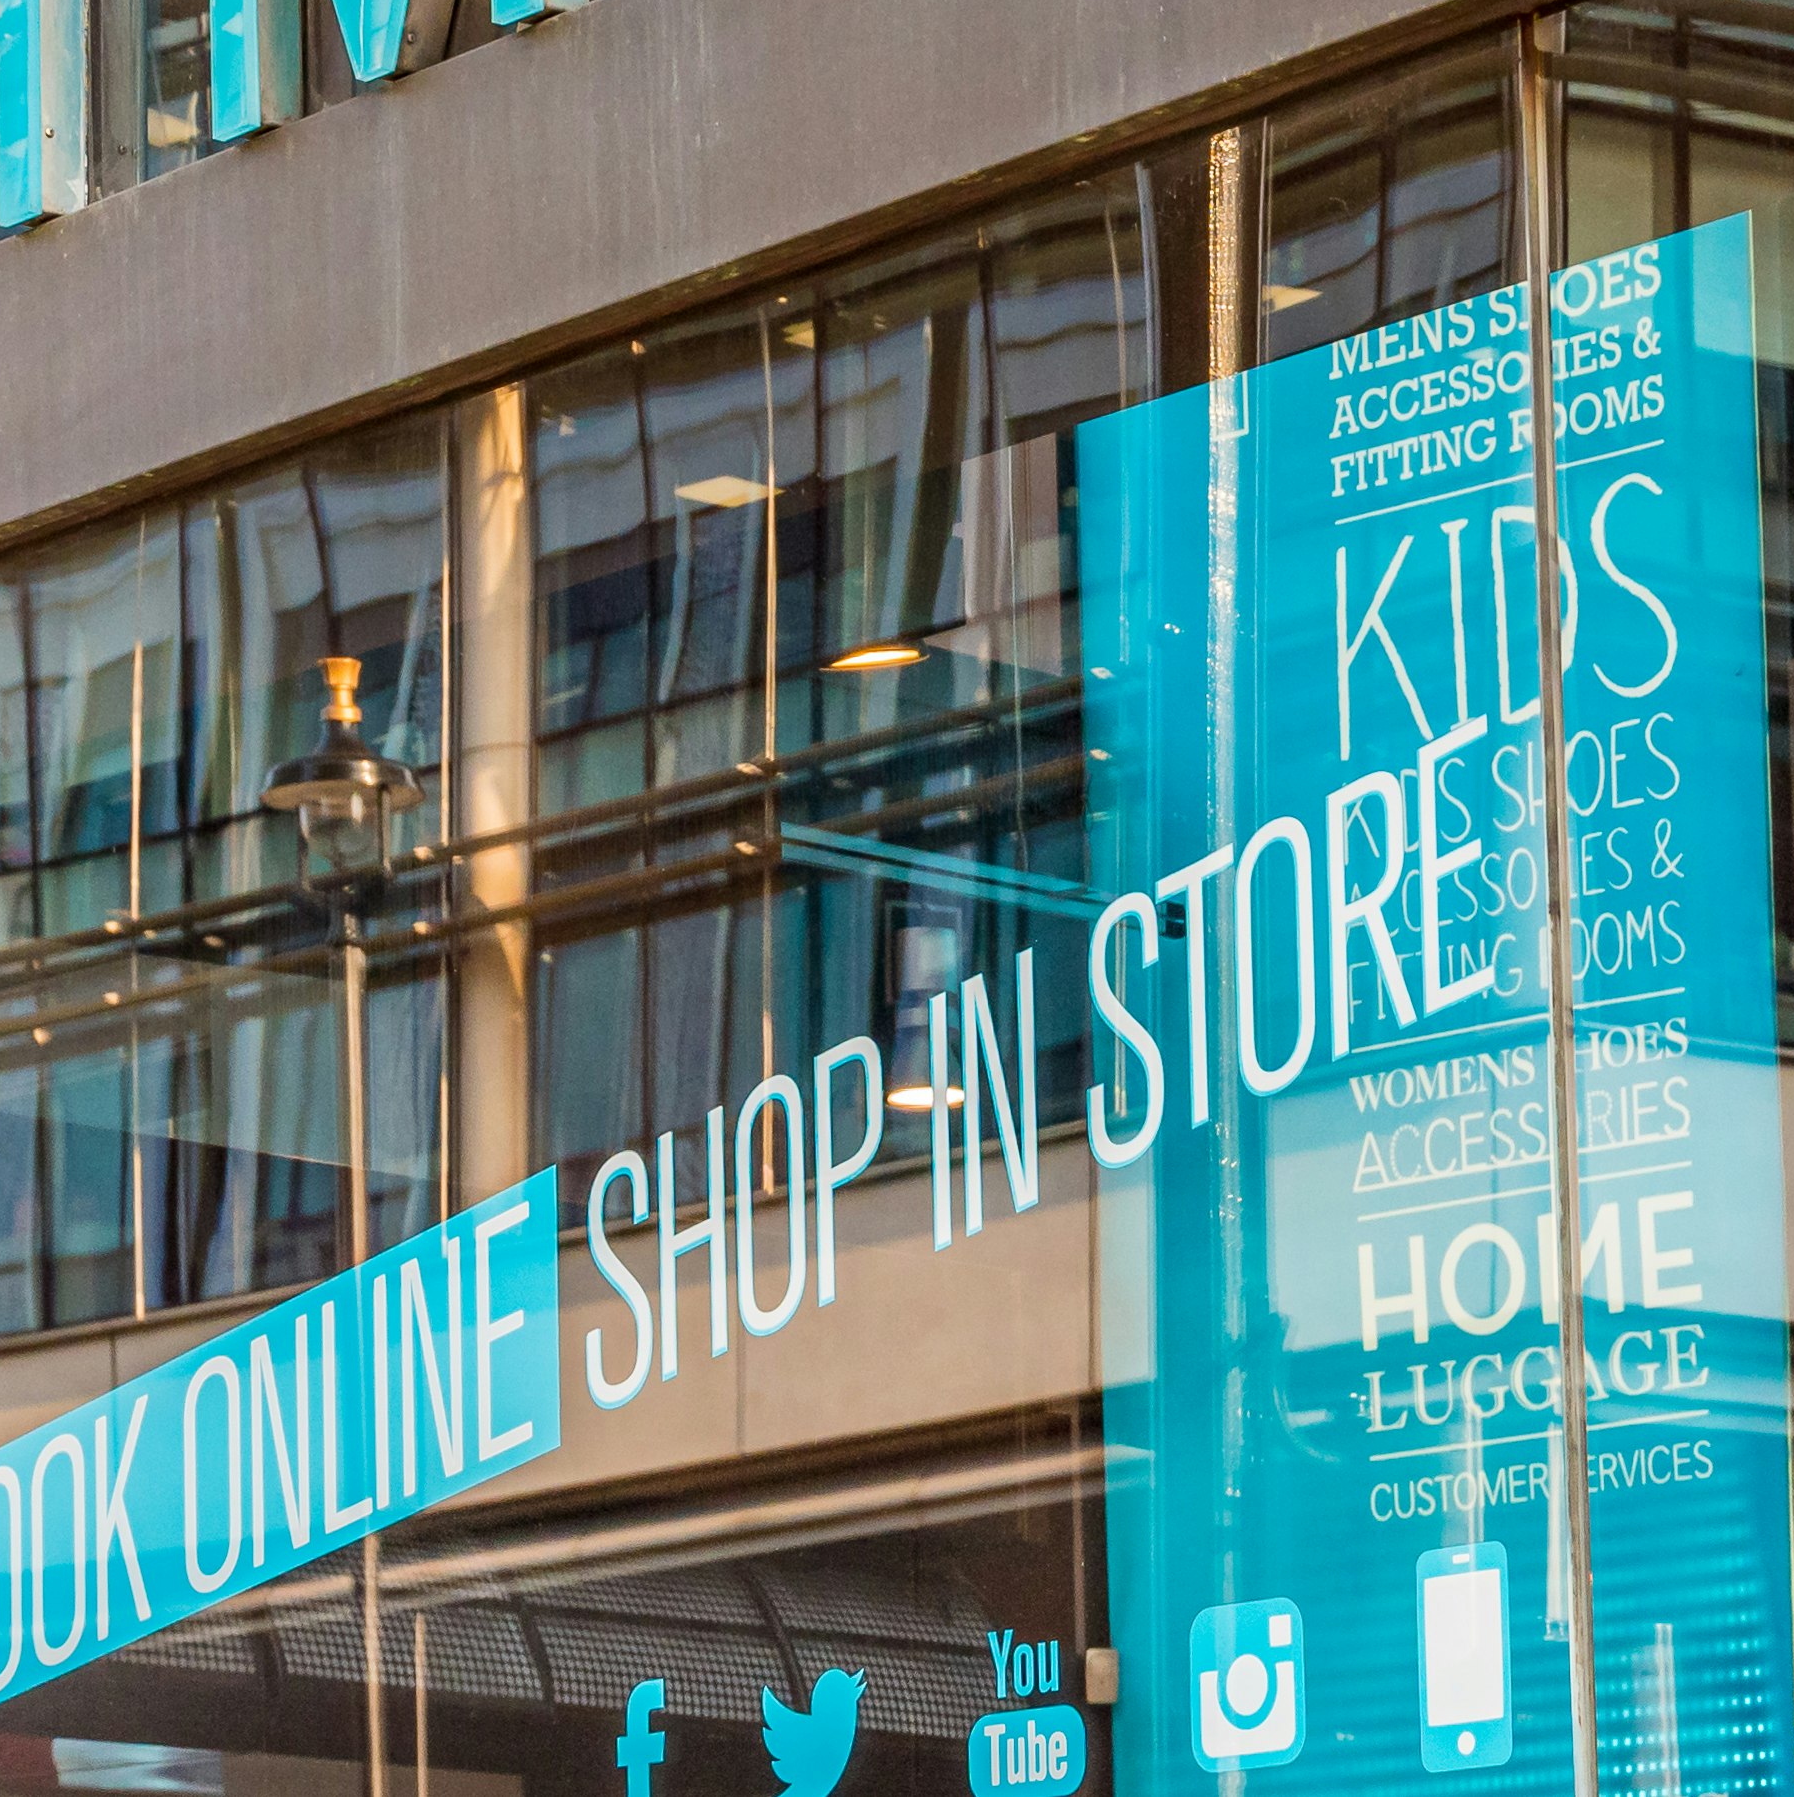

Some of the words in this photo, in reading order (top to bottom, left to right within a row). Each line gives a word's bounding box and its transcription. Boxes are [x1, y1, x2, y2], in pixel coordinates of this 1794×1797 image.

[1327, 299, 1475, 381] MENS
[1328, 325, 1622, 440] ACCESSOIES
[1632, 316, 1663, 360] &
[1330, 418, 1497, 497] FITTING
[1335, 472, 1679, 761] KIDS
[1651, 818, 1685, 879] &
[1349, 1045, 1536, 1114] WOMENS
[182, 1200, 534, 1594] ONLINE
[584, 1035, 884, 1410] SHOP
[928, 947, 1040, 1252] IN
[1087, 715, 1494, 1170] STORE
[1353, 1075, 1692, 1193] ACCESSRIES
[1357, 1190, 1703, 1352] HOME
[1369, 1462, 1550, 1522] CUSTOMER
[986, 1628, 1060, 1700] You
[983, 1718, 1069, 1788] Tube
